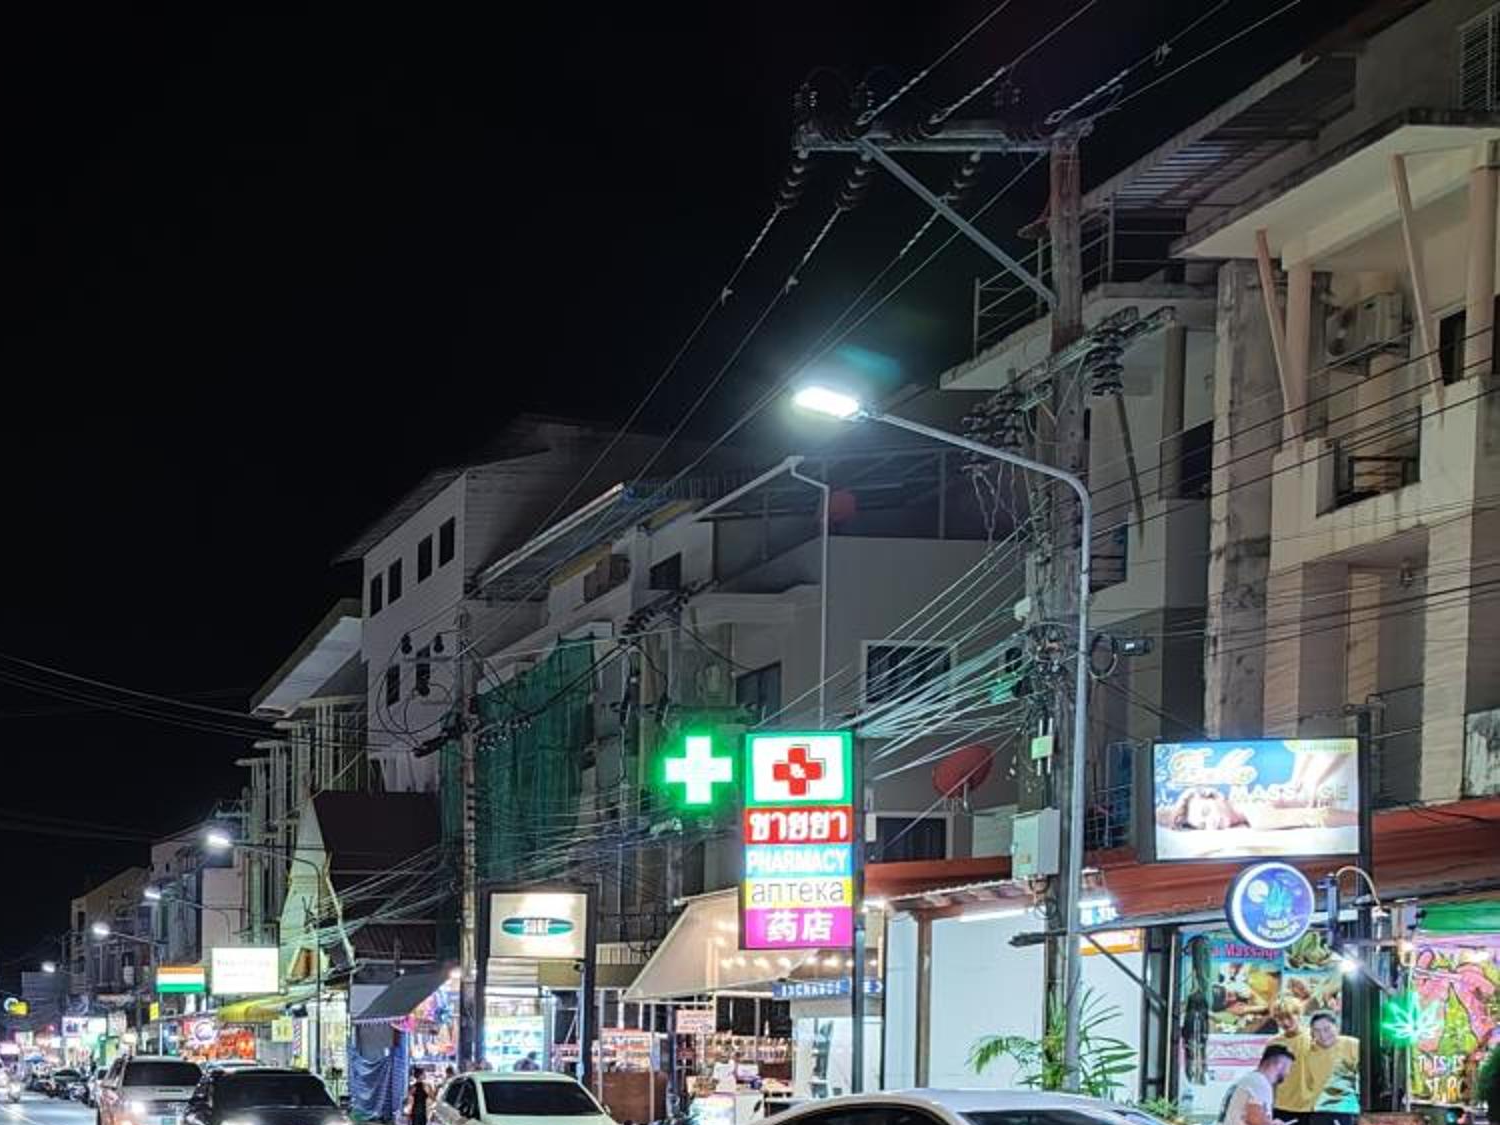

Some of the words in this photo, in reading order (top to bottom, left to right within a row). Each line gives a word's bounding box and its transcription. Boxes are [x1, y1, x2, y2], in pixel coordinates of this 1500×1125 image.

[747, 849, 848, 875] PHARMACY
[751, 882, 844, 903] аптека
[765, 911, 834, 942] 药店
